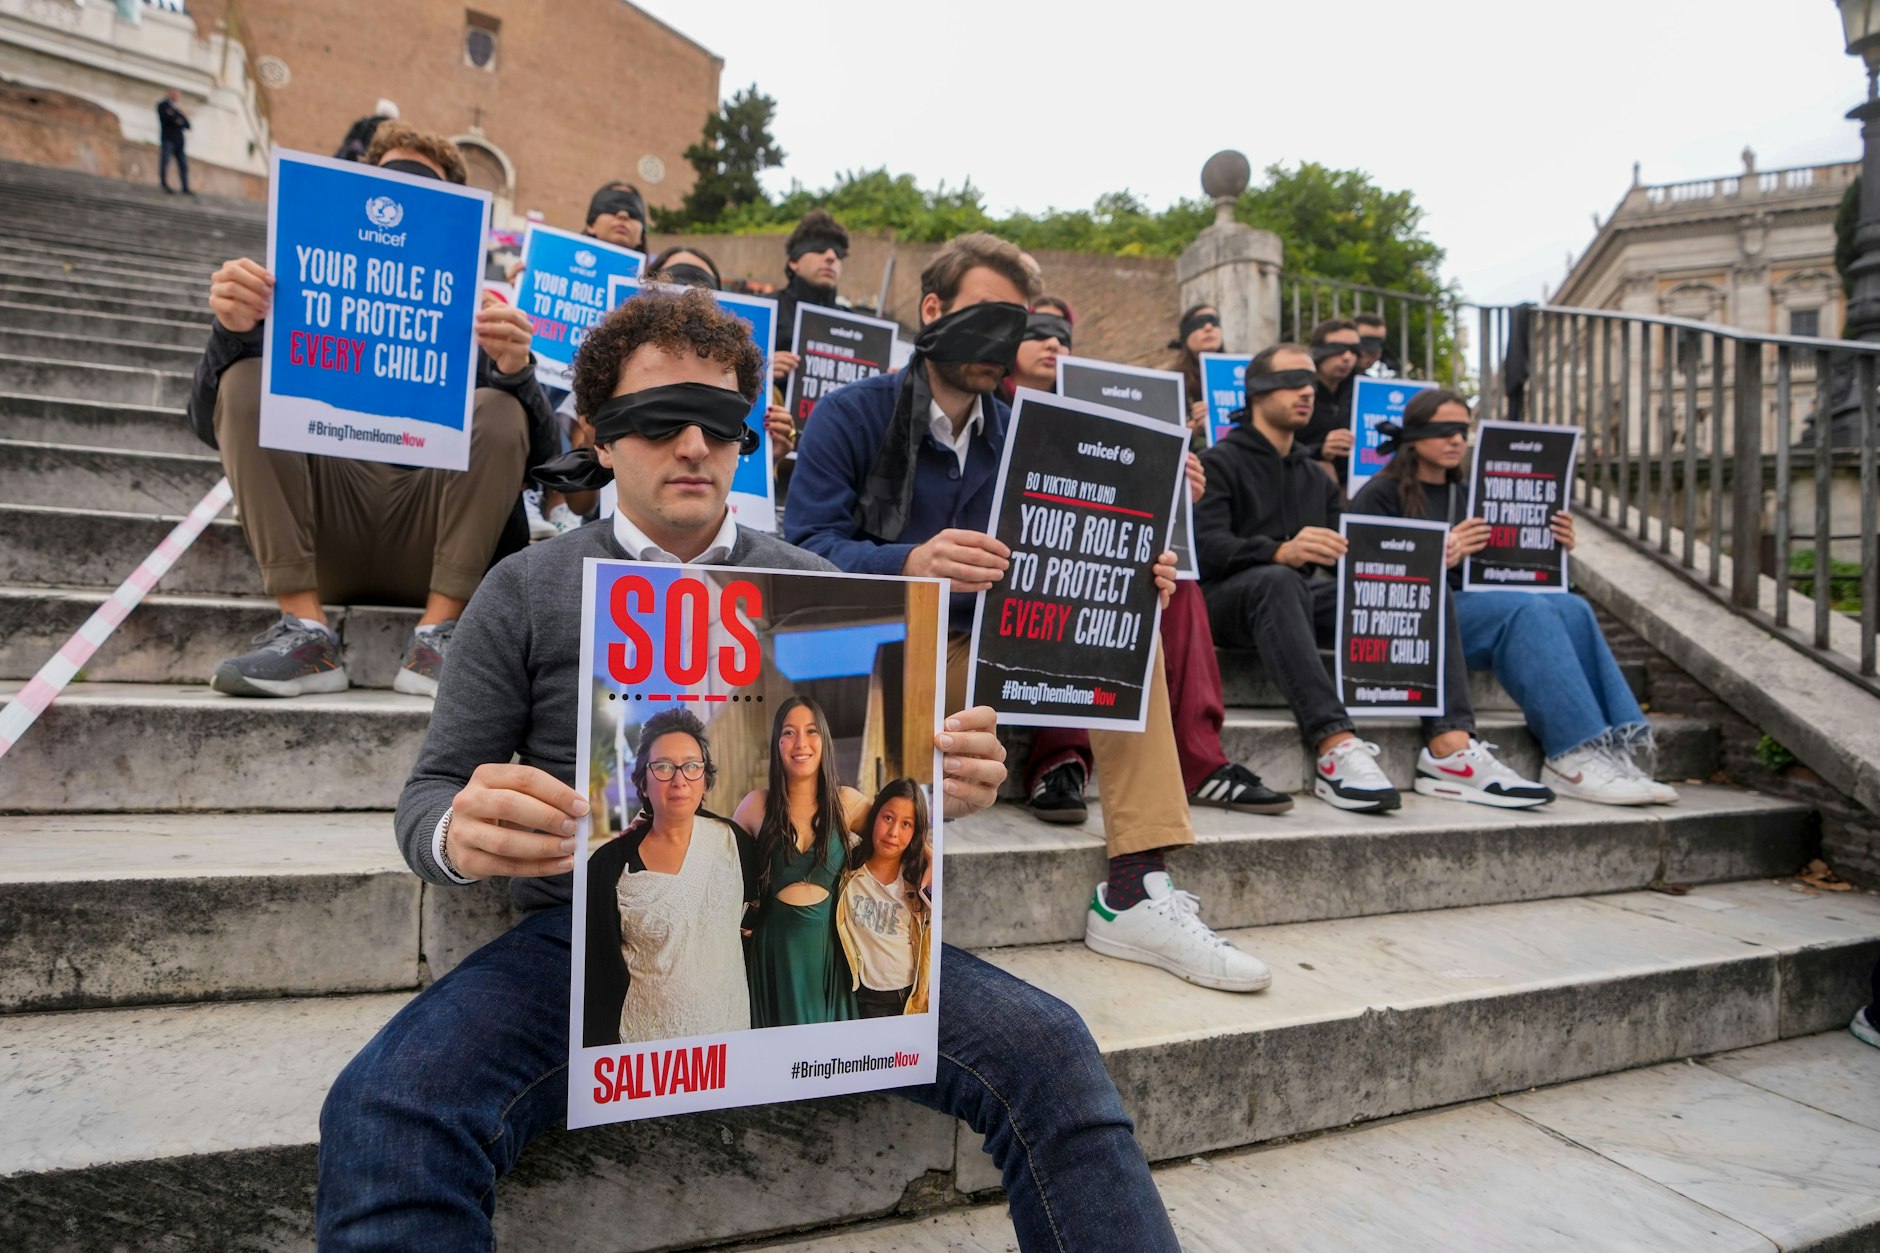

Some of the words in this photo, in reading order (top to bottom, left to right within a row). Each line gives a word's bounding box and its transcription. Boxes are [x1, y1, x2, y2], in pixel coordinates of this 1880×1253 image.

[358, 228, 406, 247] unicef
[296, 245, 357, 290] YOUR
[366, 258, 425, 301] ROLE
[433, 269, 453, 305] IS
[533, 269, 569, 298] YOUR
[570, 280, 606, 308] ROLE
[302, 290, 331, 327] TO
[341, 296, 443, 344] PROTECT
[533, 292, 552, 316] TO
[553, 299, 605, 328] PROTEC
[290, 331, 366, 374] EVERY
[374, 343, 448, 387] CHILD!
[805, 354, 835, 379] YOUR
[802, 376, 818, 398] TO
[307, 421, 426, 448] #BringThemHomeNow
[1077, 441, 1121, 462] unicef
[1026, 472, 1041, 491] BO
[1042, 475, 1078, 498] VIKTOR
[1079, 482, 1116, 505] NYLUND
[1484, 477, 1513, 501] YOUR
[1515, 479, 1543, 502] ROLE
[1545, 480, 1557, 502] IS
[1482, 501, 1498, 524] TO
[1501, 502, 1549, 526] PROTECT
[1020, 503, 1078, 551] YOUR
[1080, 515, 1132, 560] ROLE
[1135, 524, 1153, 563] IS
[1488, 526, 1518, 548] VERY
[1010, 551, 1038, 593] TO
[1042, 556, 1135, 605] PROTECT
[1353, 581, 1385, 608] YOUR
[1388, 582, 1418, 610] ROLE
[1419, 585, 1431, 610] IS
[607, 574, 764, 688] SOS
[1000, 598, 1072, 642] EVERY
[1074, 608, 1141, 650] CHILD!
[1352, 609, 1369, 635] TO
[1370, 610, 1422, 637] PROTECT
[1350, 638, 1389, 663] EVERY
[1390, 639, 1430, 665] CHILD!
[1002, 680, 1116, 707] #BringThemHomeNow
[593, 1044, 727, 1104] SALVAMI
[790, 1050, 920, 1082] #BringThemHomeNow
